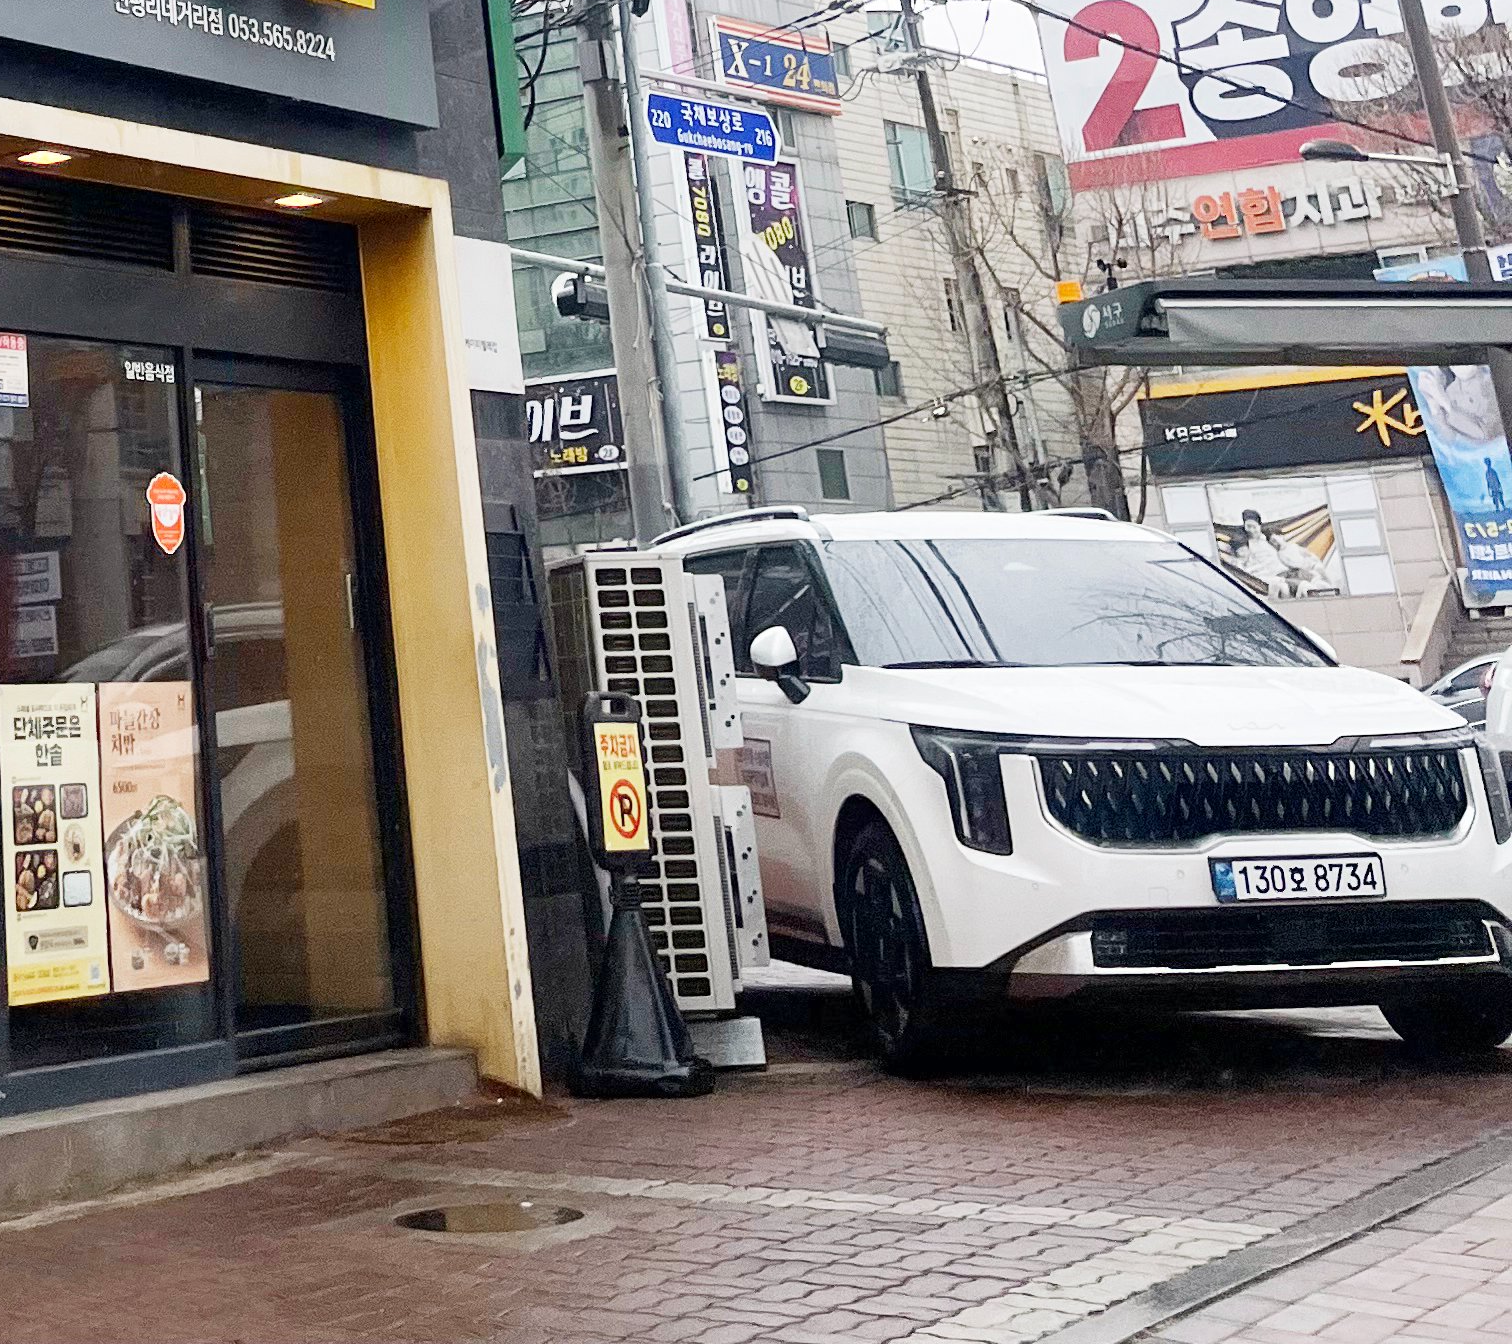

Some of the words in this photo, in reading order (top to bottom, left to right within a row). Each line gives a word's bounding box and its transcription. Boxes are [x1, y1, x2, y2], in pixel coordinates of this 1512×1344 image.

[227, 12, 337, 62] 053.565.8224
[782, 52, 812, 91] 24
[650, 108, 672, 129] 220
[680, 101, 745, 134] 국채보상로
[754, 127, 774, 147] 216
[676, 127, 754, 156] Gukchaebosang-ro
[744, 166, 796, 212] 앵콜
[692, 186, 712, 238] 7080
[123, 360, 175, 385] 일반음식점
[550, 446, 588, 464] 노래방
[13, 715, 82, 741] 단체주문은
[599, 734, 639, 759] 주차금지
[1313, 862, 1377, 893] 8734
